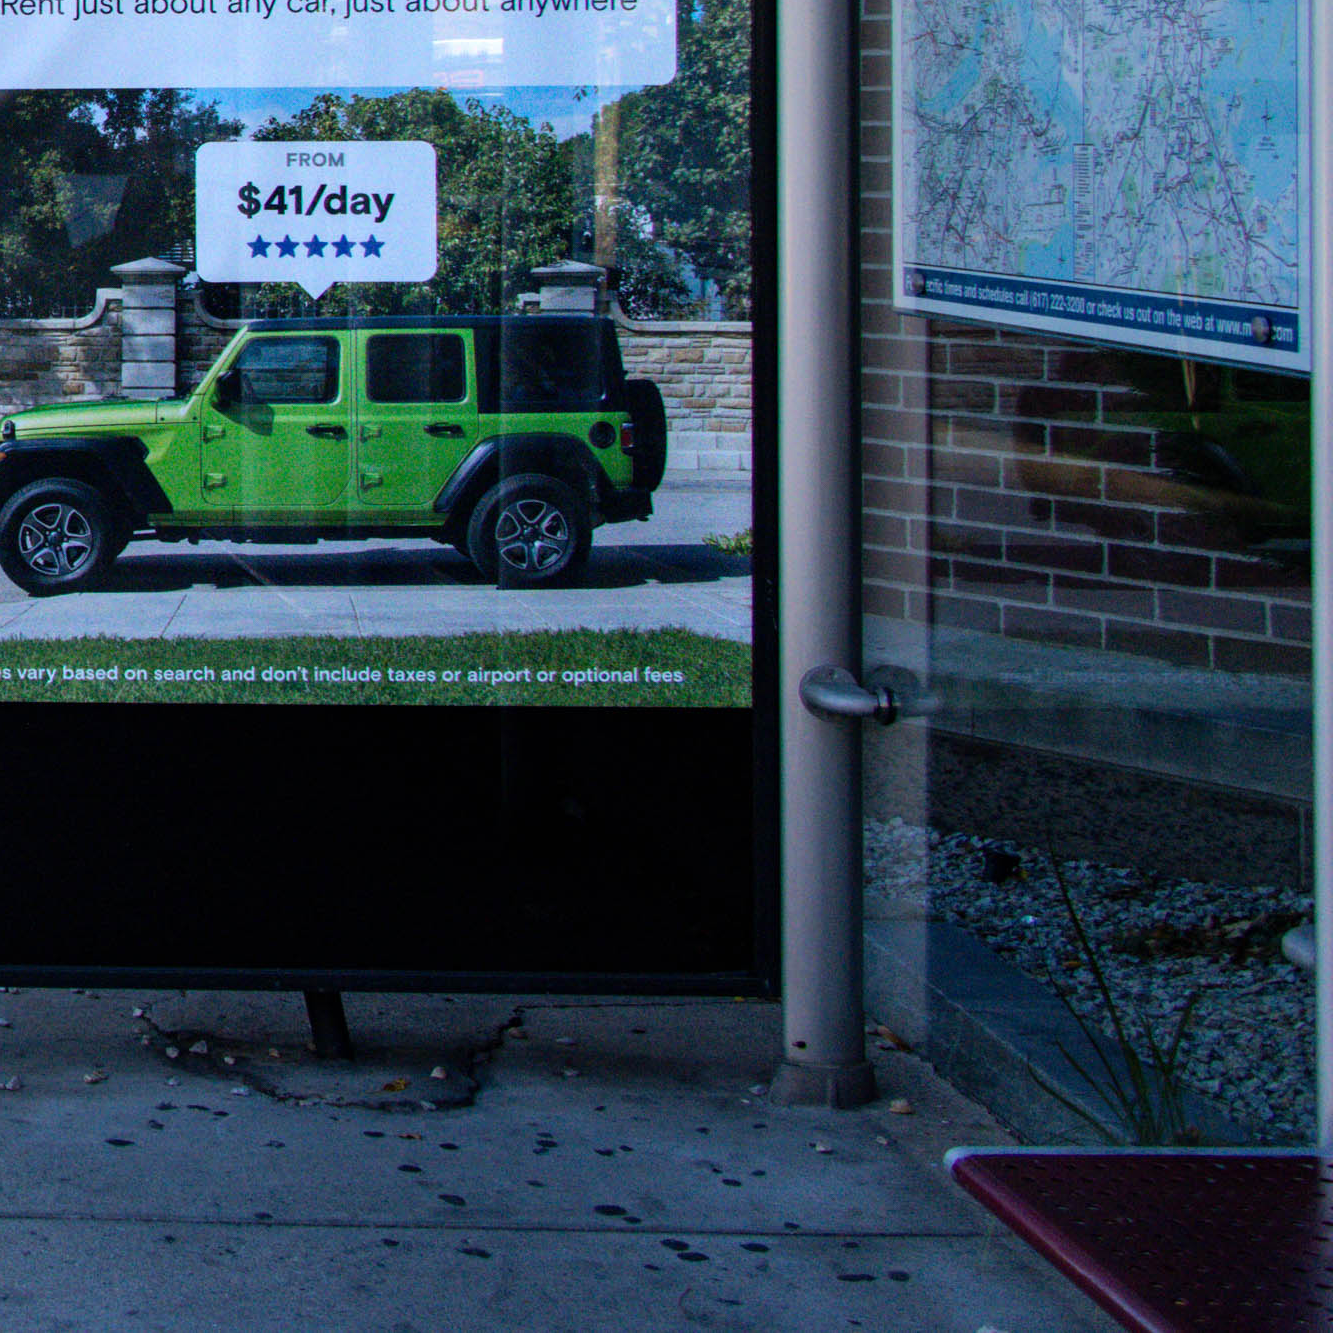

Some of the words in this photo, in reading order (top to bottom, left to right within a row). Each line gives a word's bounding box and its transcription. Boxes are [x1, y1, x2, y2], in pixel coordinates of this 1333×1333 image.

[286, 152, 345, 168] FROM
[237, 183, 394, 223] $41/day
[926, 280, 943, 295] ecific
[964, 283, 977, 299] and
[978, 284, 1014, 304] schedules
[1015, 290, 1029, 305] call
[1030, 291, 1049, 311] (617)
[1086, 302, 1096, 313] or
[1097, 301, 1122, 318] check
[1124, 307, 1134, 321] us
[1136, 306, 1151, 323] out
[1153, 311, 1165, 324] on
[1167, 309, 1181, 327] the
[1183, 312, 1203, 330] web
[1205, 316, 1215, 332] at
[1217, 318, 1293, 343] www.mcom
[17, 669, 57, 685] vary
[62, 664, 119, 681] based
[124, 669, 149, 681] on
[153, 664, 216, 681] search
[221, 664, 256, 682] and
[261, 665, 309, 683] don't
[313, 665, 382, 683] include
[387, 667, 437, 683] taxes
[442, 670, 462, 683] or
[467, 666, 532, 687] airport
[537, 671, 557, 683] or
[562, 666, 640, 687] optional
[644, 666, 684, 684] fees
